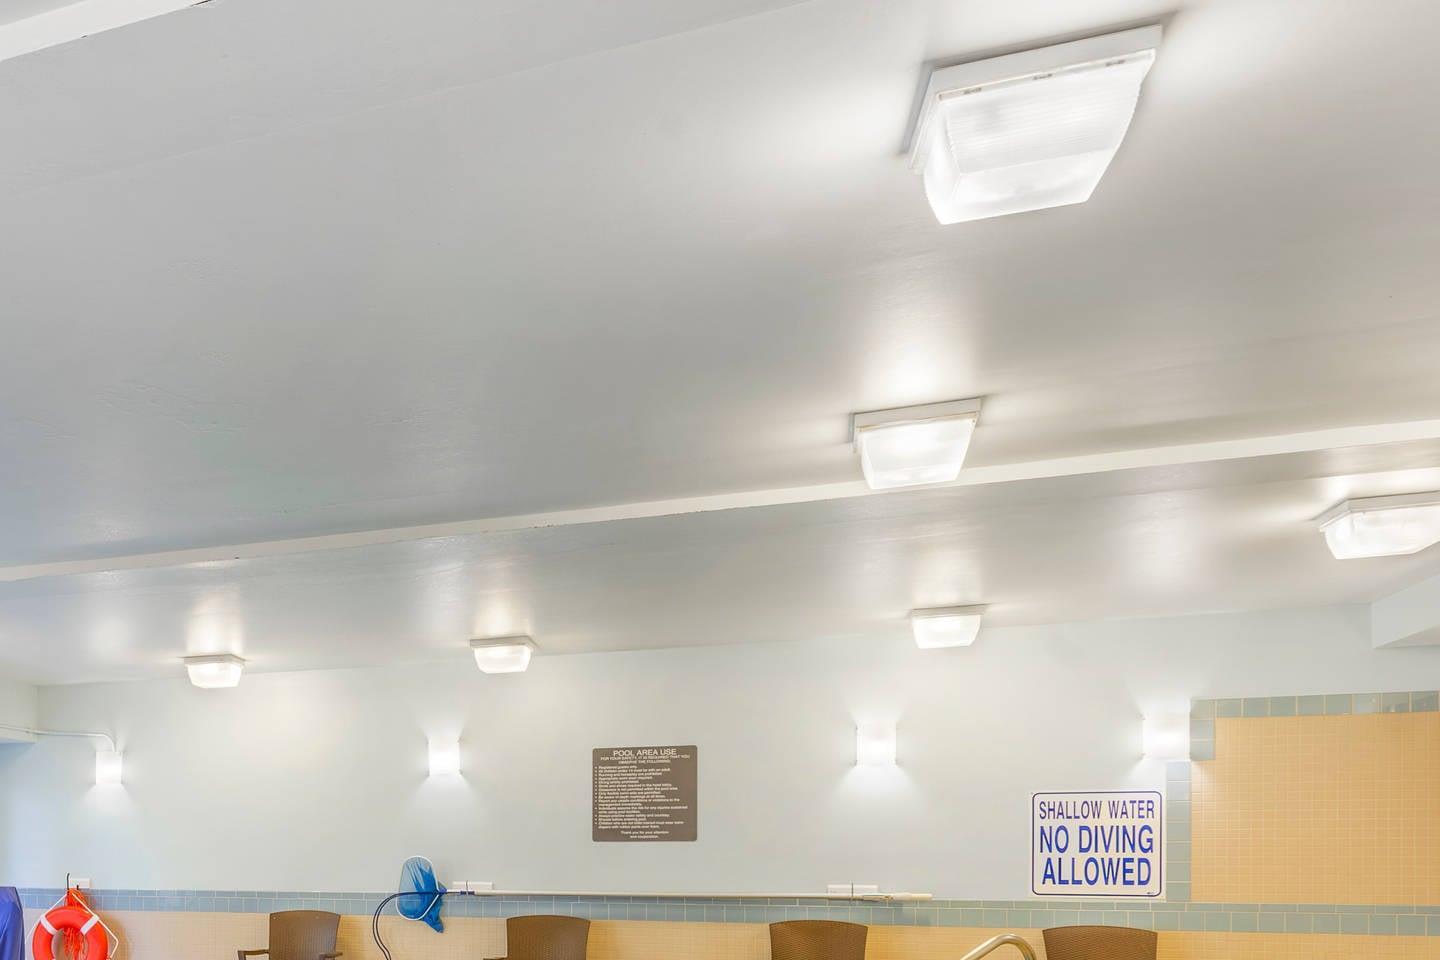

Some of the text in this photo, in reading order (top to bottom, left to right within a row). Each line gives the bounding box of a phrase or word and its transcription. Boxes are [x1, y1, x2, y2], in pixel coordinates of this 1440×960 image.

[1039, 800, 1155, 820] SHALLOW WATER
[1040, 824, 1154, 854] NO DIVING
[1042, 857, 1151, 886] ALLOWED
